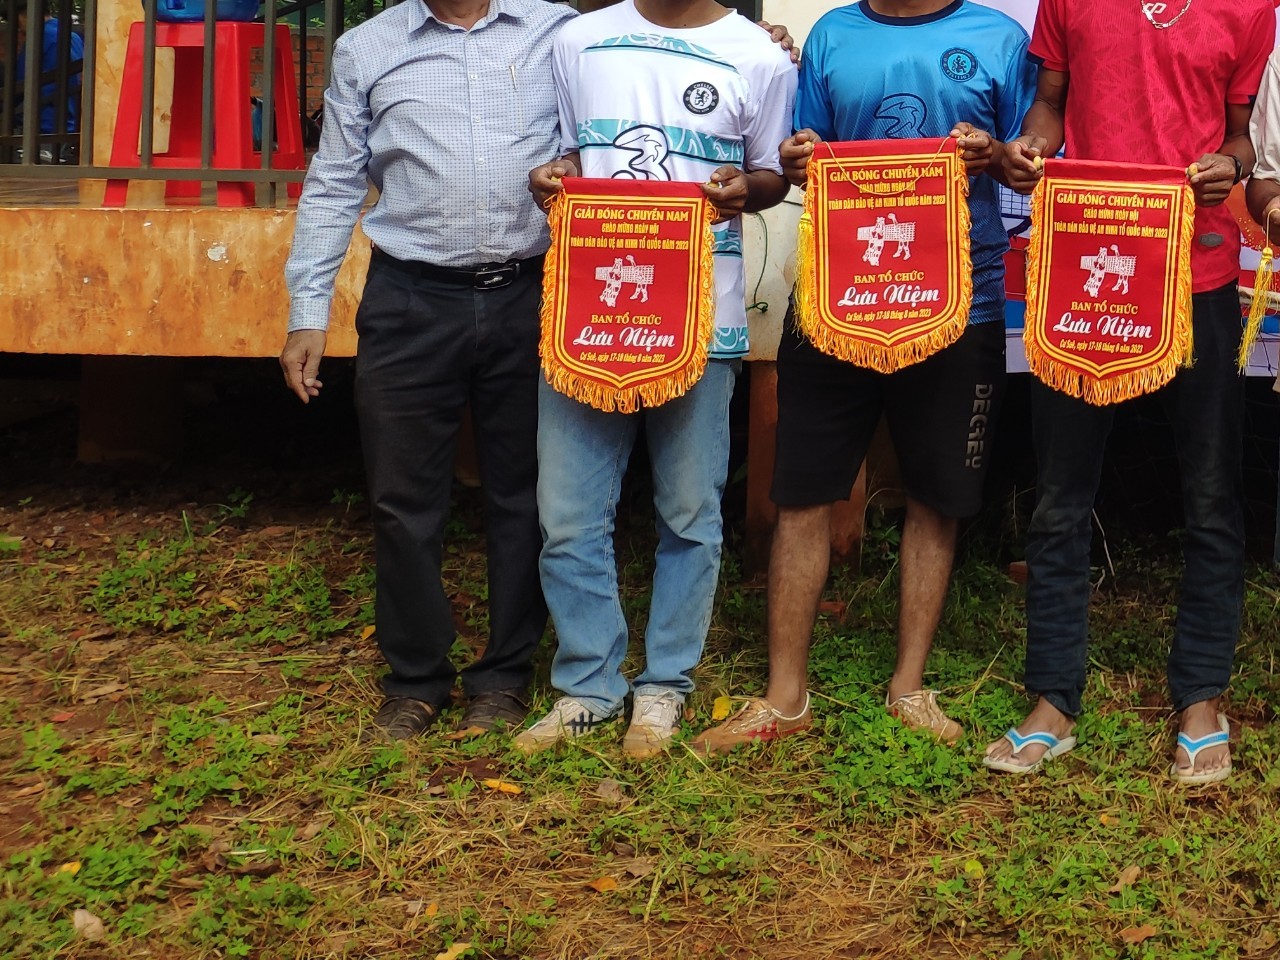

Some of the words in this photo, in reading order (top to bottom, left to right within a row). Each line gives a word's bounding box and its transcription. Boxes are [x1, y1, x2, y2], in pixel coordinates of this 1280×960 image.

[853, 169, 880, 180] BÓNG
[1057, 191, 1076, 204] GIẢI
[1078, 193, 1105, 205] BÓNG
[1108, 194, 1144, 207] CHUYỀN
[1146, 198, 1168, 209] NAM
[575, 206, 594, 219] GIẢI
[597, 207, 624, 220] BÓNG
[627, 208, 664, 220] CHUYỀN
[666, 211, 688, 221] NAM
[854, 275, 875, 283] BAN
[878, 270, 892, 282] TỔ
[895, 270, 924, 281] CHỨC
[837, 287, 879, 306] Lưu
[883, 284, 940, 307] Niệm
[1071, 302, 1091, 311] BAN
[1094, 300, 1107, 312] TỔ
[1110, 303, 1138, 314] CHỨC
[591, 315, 613, 324] BAN
[615, 312, 629, 324] TỔ
[632, 314, 661, 325] CHỨC
[1053, 312, 1092, 333] Lưu
[1097, 315, 1152, 342] Niệm
[573, 326, 614, 346] Lưu
[619, 327, 675, 352] Niệm
